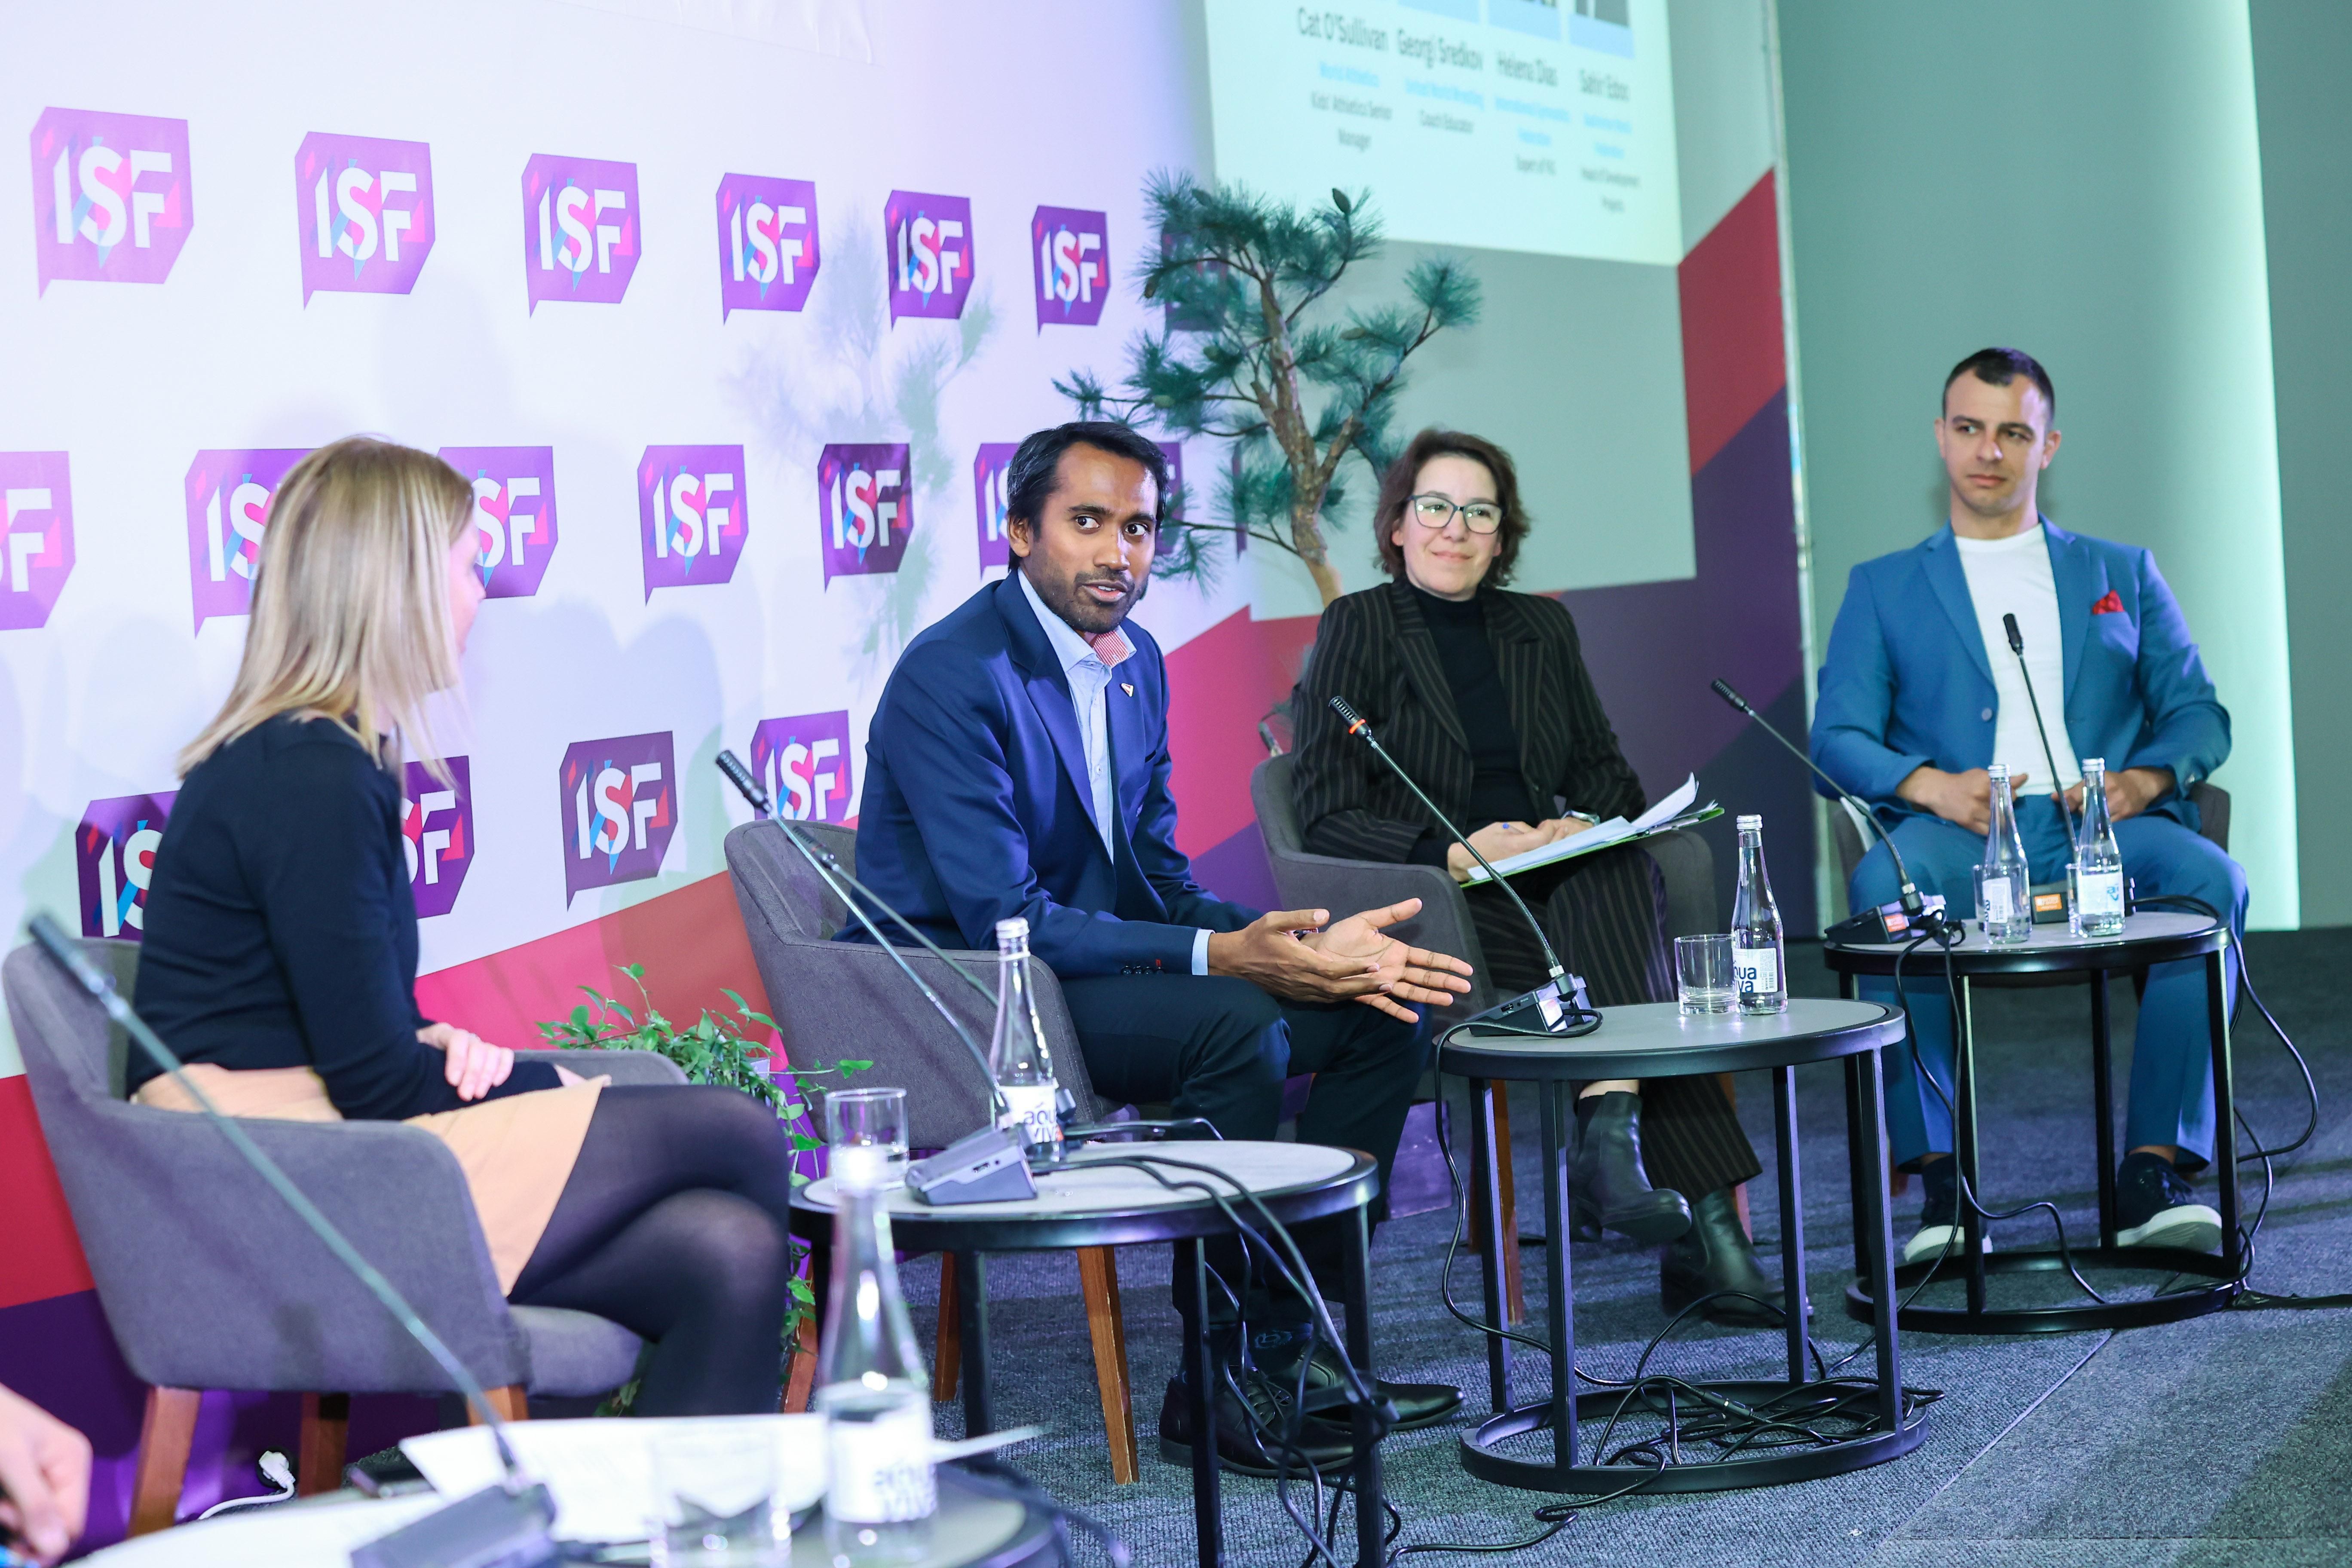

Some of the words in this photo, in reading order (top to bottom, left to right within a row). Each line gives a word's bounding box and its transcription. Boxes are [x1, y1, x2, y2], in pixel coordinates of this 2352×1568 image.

[1298, 7, 1321, 38] Cat
[1324, 12, 1388, 51] O'Sullivan
[53, 145, 172, 248] ISF
[314, 166, 418, 262] ISF
[539, 185, 626, 274] ISF
[731, 202, 806, 284] ISF
[897, 217, 964, 294] ISF
[1041, 229, 1102, 303] ISF
[206, 482, 273, 582] IS
[471, 477, 541, 567] SF
[653, 472, 734, 558] ISF
[831, 469, 901, 550] ISF
[576, 762, 662, 860] ISF
[765, 738, 839, 821] ISF
[98, 829, 162, 937] IS
